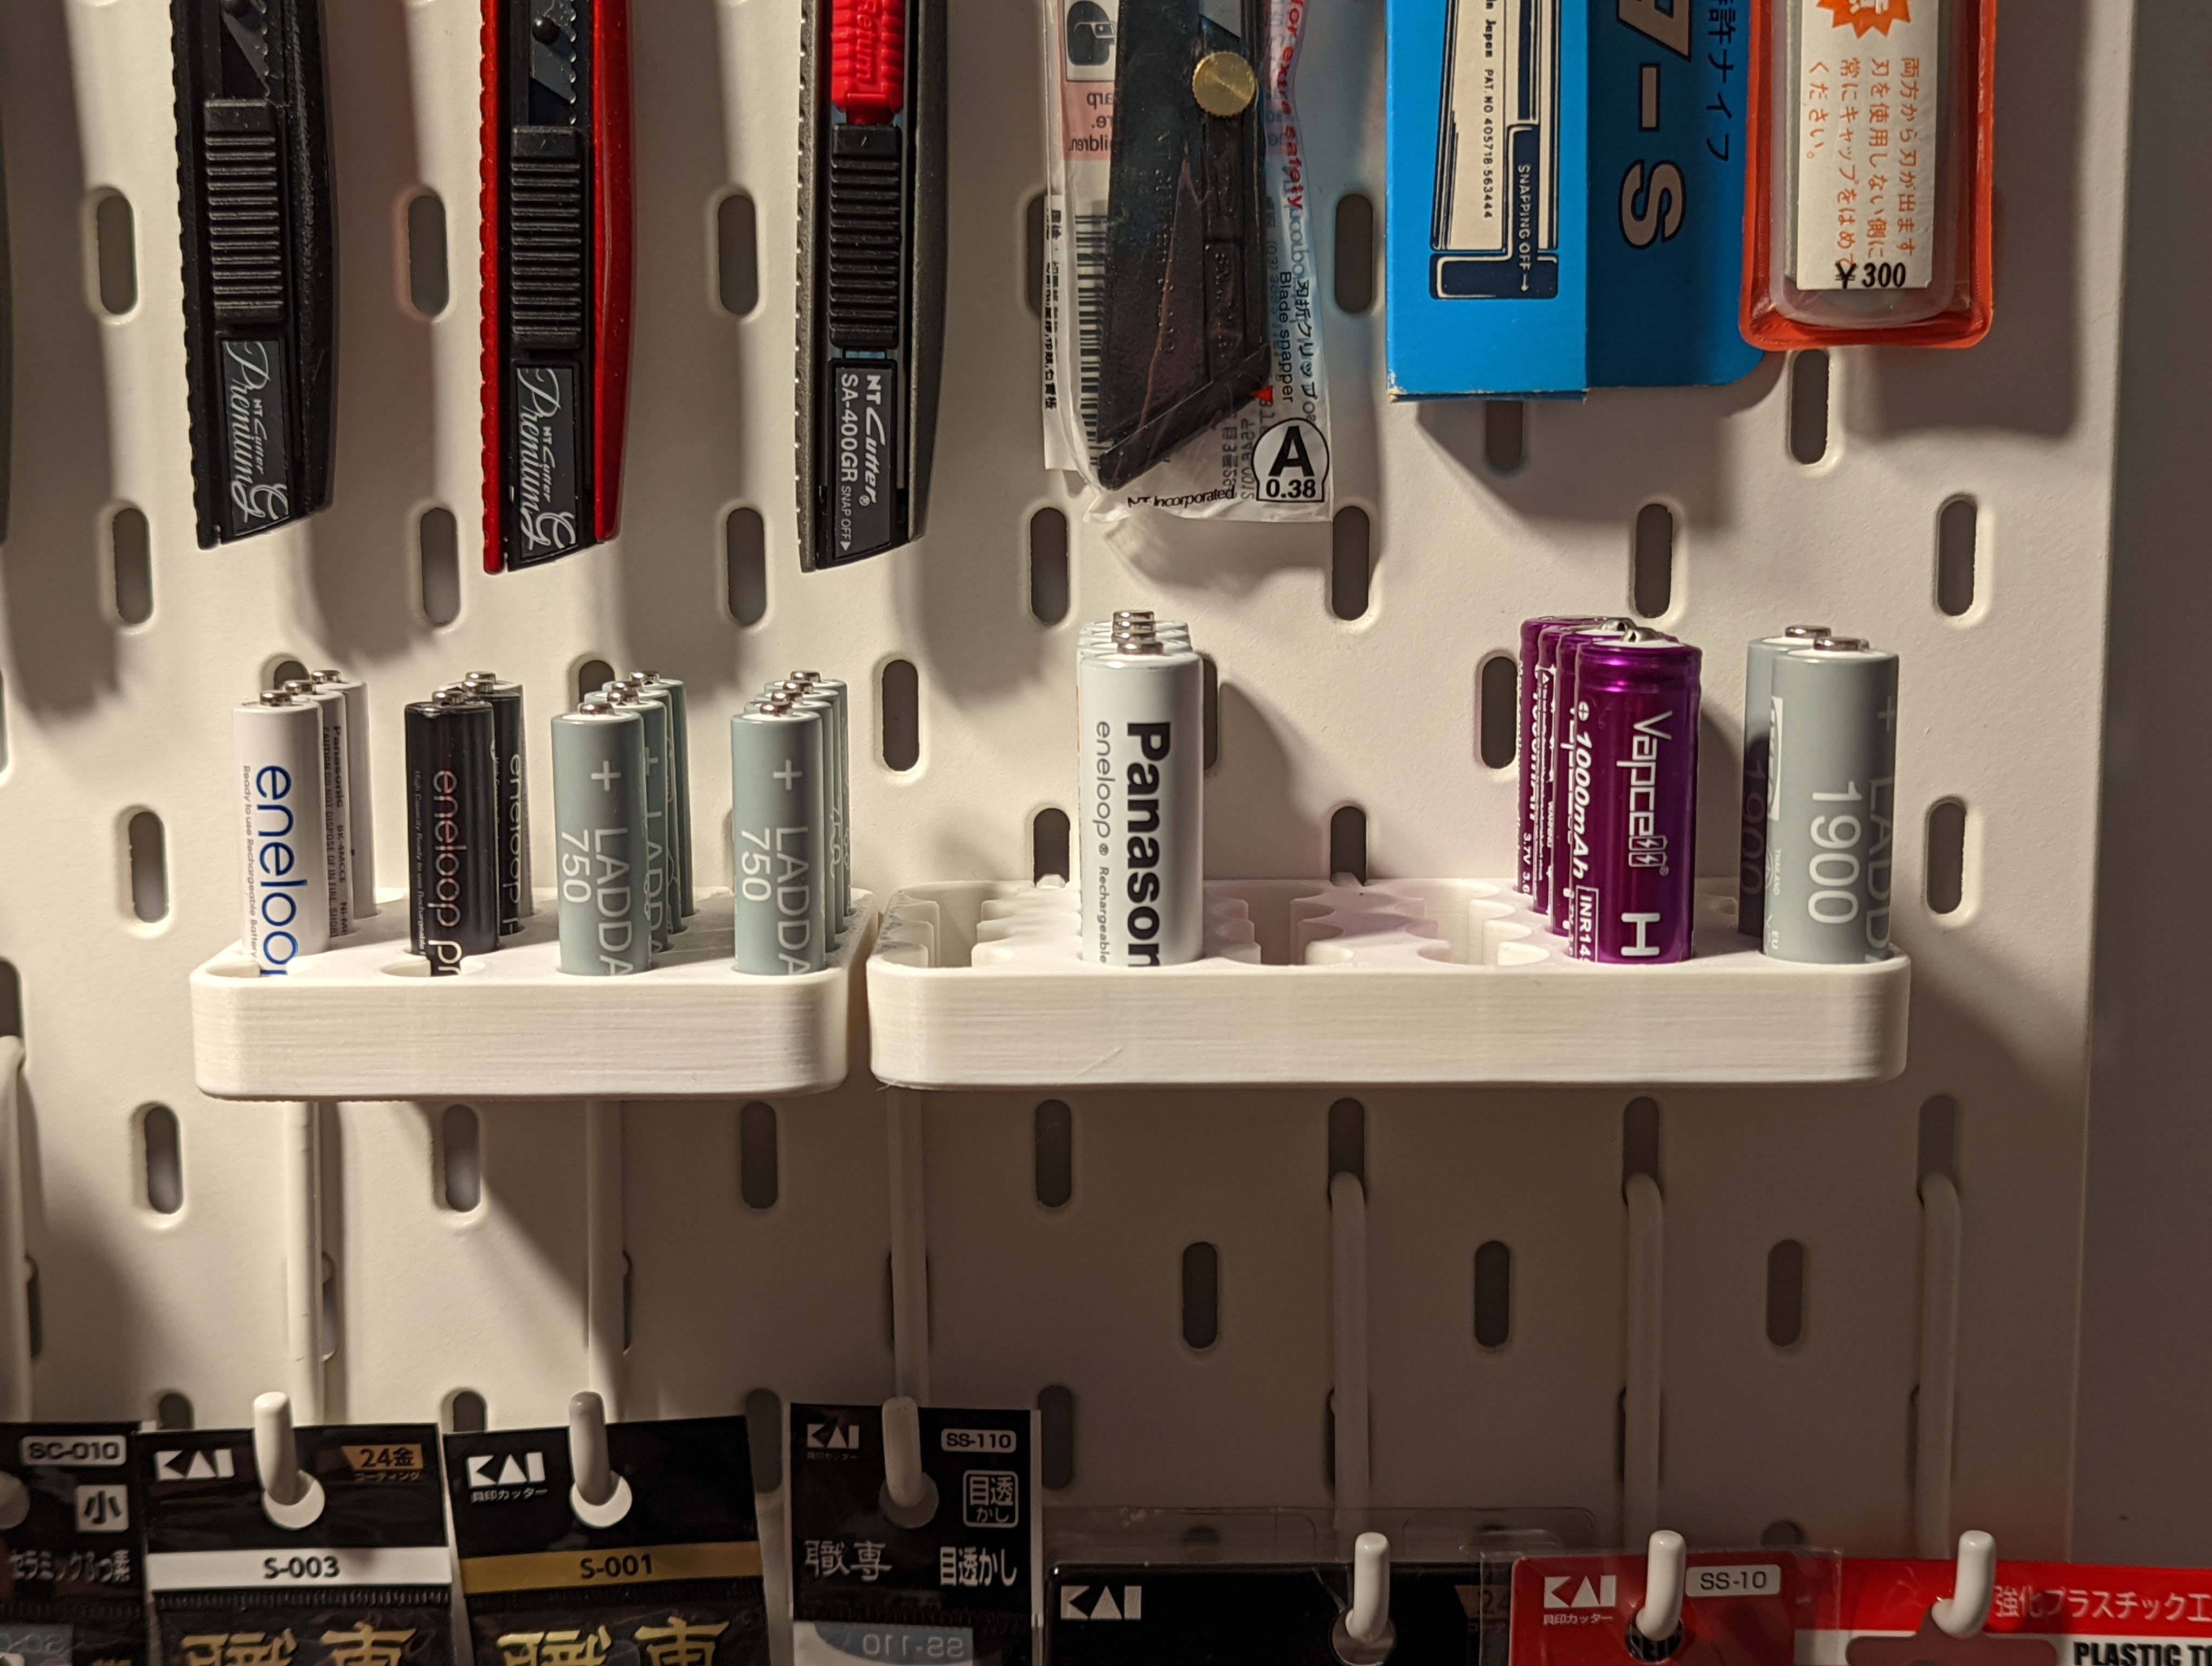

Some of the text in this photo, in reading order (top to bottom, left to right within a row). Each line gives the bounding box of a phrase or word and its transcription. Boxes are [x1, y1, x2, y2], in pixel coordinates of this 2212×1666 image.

[1484, 20, 1496, 57] Japan
[1281, 47, 1293, 114] extra
[1808, 61, 1829, 159] ください。
[1285, 125, 1304, 210] safety
[1867, 57, 1889, 258] 刃を使用しない側に
[1897, 57, 1920, 257] 両方から刃が出ます
[1518, 164, 1531, 271] SNAPPING OFF
[1836, 263, 1906, 289] ¥300
[1279, 272, 1294, 402] Blade snapper
[224, 342, 270, 485] Premium
[253, 399, 268, 475] NT Cutter
[517, 369, 561, 512] Premium
[840, 373, 858, 540] SA-400GR SNAP OFF
[865, 374, 885, 504] NT Cutter
[1268, 426, 1315, 477] A
[543, 426, 555, 503] NT Cutter
[1153, 486, 1235, 508] Incorporated
[1266, 479, 1316, 498] 0.38
[243, 766, 252, 802] Ready
[333, 725, 345, 808] Panasonic
[245, 804, 253, 815] to
[1573, 731, 1593, 879] 1000mAh
[427, 770, 467, 927] eneloop
[503, 753, 522, 904] eneloop
[1092, 721, 1116, 964] eneloop Rechargeable
[1522, 832, 1532, 866] 3.7V
[561, 829, 591, 904] 750
[741, 828, 772, 902] 750
[1773, 849, 1782, 895] THAILAND
[1808, 780, 1862, 925] 1900
[1865, 778, 1892, 962] LADD
[246, 839, 258, 916] Rechargeable
[595, 828, 634, 976] LADDA
[776, 826, 811, 975] LADDA
[250, 919, 259, 958] Battery
[1621, 912, 1661, 957] H
[1771, 931, 1779, 950] EU
[29, 1441, 120, 1461] SC-010
[359, 1447, 414, 1469] 24金
[807, 1424, 859, 1449] KAI
[946, 1433, 1012, 1449] SS-110
[156, 1449, 234, 1481] KAI
[467, 1452, 545, 1488] KAI
[85, 1490, 122, 1524] 小
[471, 1487, 548, 1503] 貝印カッター
[969, 1476, 1014, 1507] 目透
[976, 1508, 1009, 1522] かし
[264, 1556, 340, 1579] S-003
[581, 1554, 653, 1579] S-001
[805, 1540, 893, 1582] 職専
[939, 1546, 1018, 1587] 目透かし
[1700, 1571, 1767, 1590] SS-10
[1060, 1585, 1142, 1620] KAI
[1544, 1575, 1617, 1609] KAI
[1543, 1613, 1613, 1625] 貝印カッター
[2073, 1642, 2181, 1666] PLASTIC
